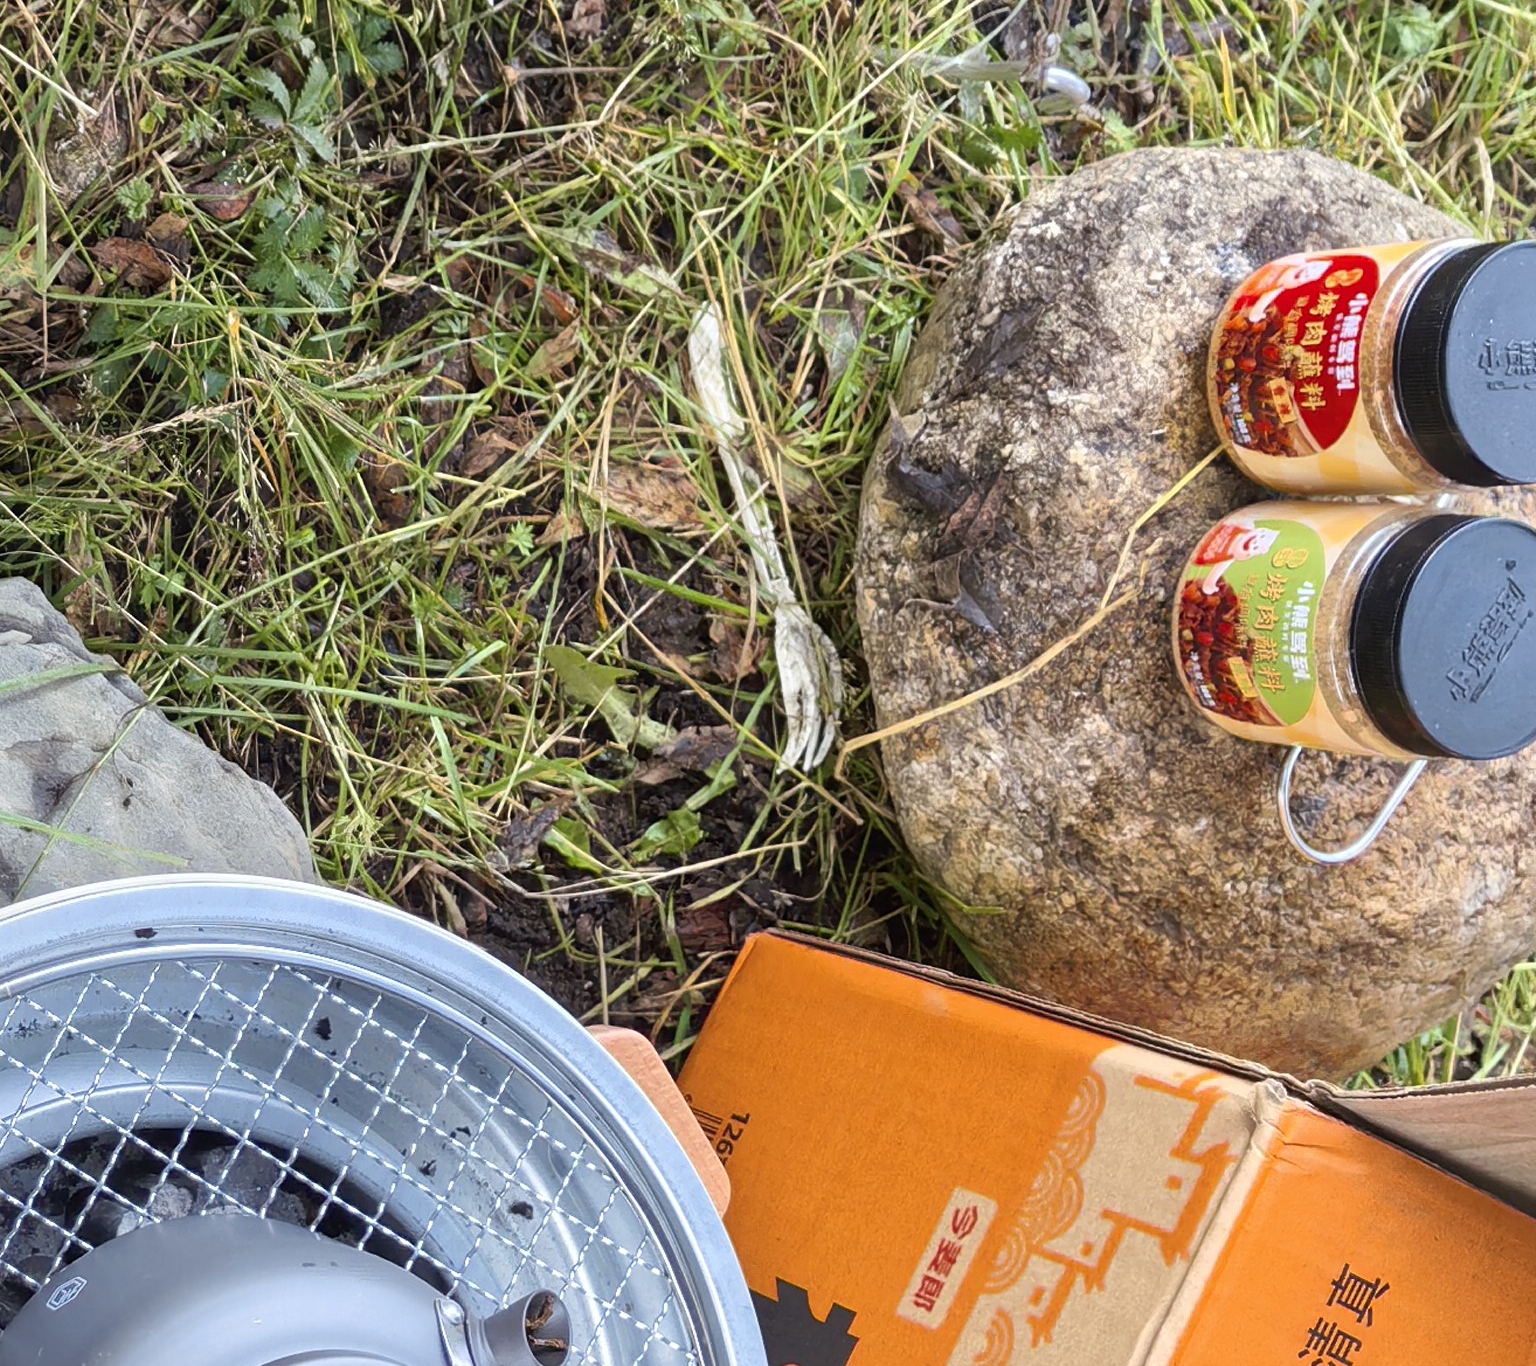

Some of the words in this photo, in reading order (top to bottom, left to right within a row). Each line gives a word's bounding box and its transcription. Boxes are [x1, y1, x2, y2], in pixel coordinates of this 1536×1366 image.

[1297, 291, 1340, 411] 烤肉蘸料
[1254, 571, 1288, 693] 烤肉蘸料
[716, 1113, 750, 1166] 126
[910, 1203, 980, 1315] 今麦郎
